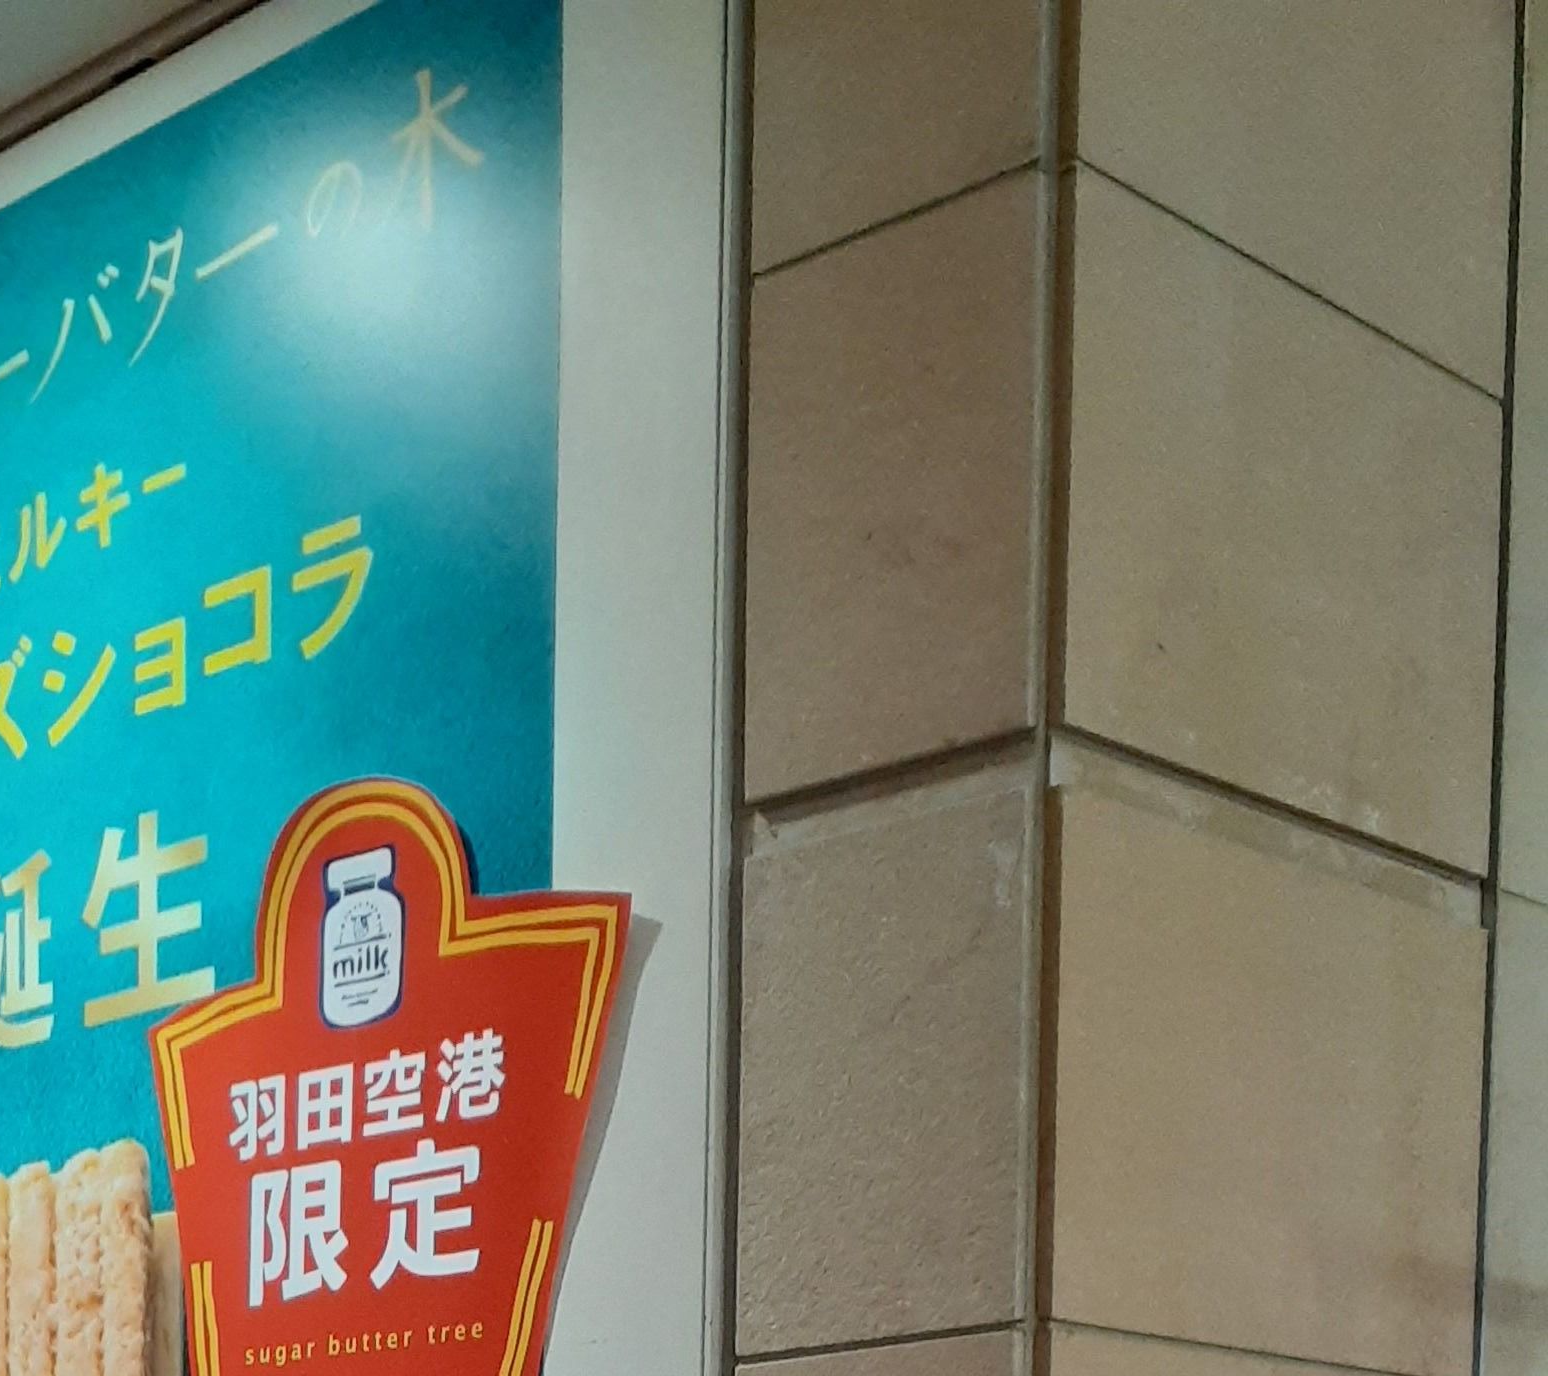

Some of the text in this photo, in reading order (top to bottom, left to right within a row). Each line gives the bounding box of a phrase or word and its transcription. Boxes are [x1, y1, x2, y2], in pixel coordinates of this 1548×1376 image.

[332, 944, 390, 979] milk
[227, 1029, 507, 1160] 羽田空港
[246, 1139, 482, 1309] 限定
[244, 1321, 484, 1367] sugar butter tree
